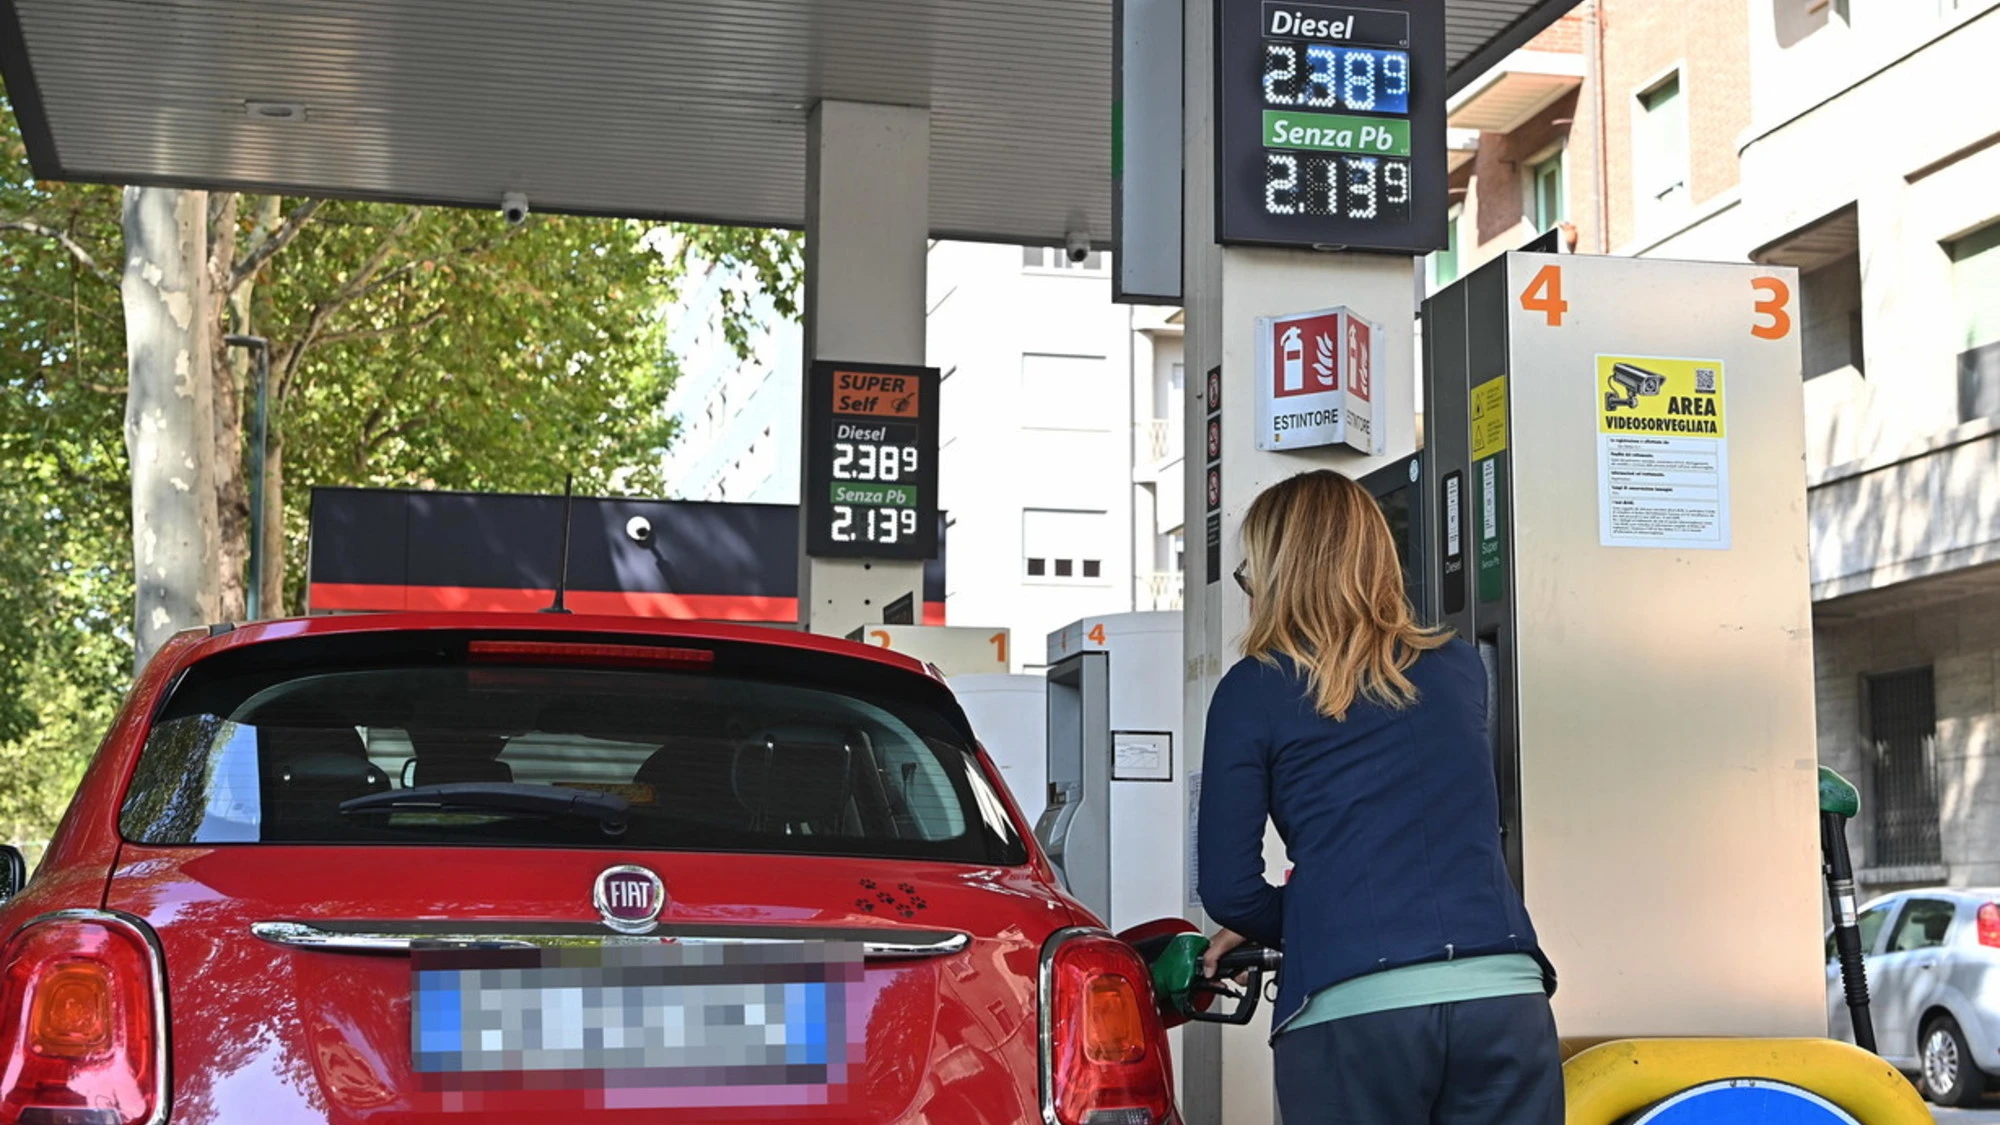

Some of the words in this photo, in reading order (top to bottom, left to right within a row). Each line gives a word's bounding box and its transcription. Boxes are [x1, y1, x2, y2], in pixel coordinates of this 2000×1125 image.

[1270, 10, 1355, 40] Diesel
[1271, 119, 1353, 149] Senza
[1358, 126, 1393, 151] Pb
[1519, 264, 1568, 326] 4
[1750, 277, 1791, 340] 3
[839, 374, 906, 393] SUPER
[838, 396, 879, 413] Self
[1667, 396, 1717, 417] AREA
[1273, 408, 1338, 431] ESTINTORE
[1605, 415, 1718, 434] VIDEOSORVEGLIATA
[837, 424, 886, 441] Diesel
[835, 486, 882, 503] Senza
[885, 488, 907, 504] Pb
[831, 504, 917, 544] 2.139
[1088, 623, 1107, 646] 4
[989, 632, 1008, 663] 1
[610, 880, 651, 909] FIAT
